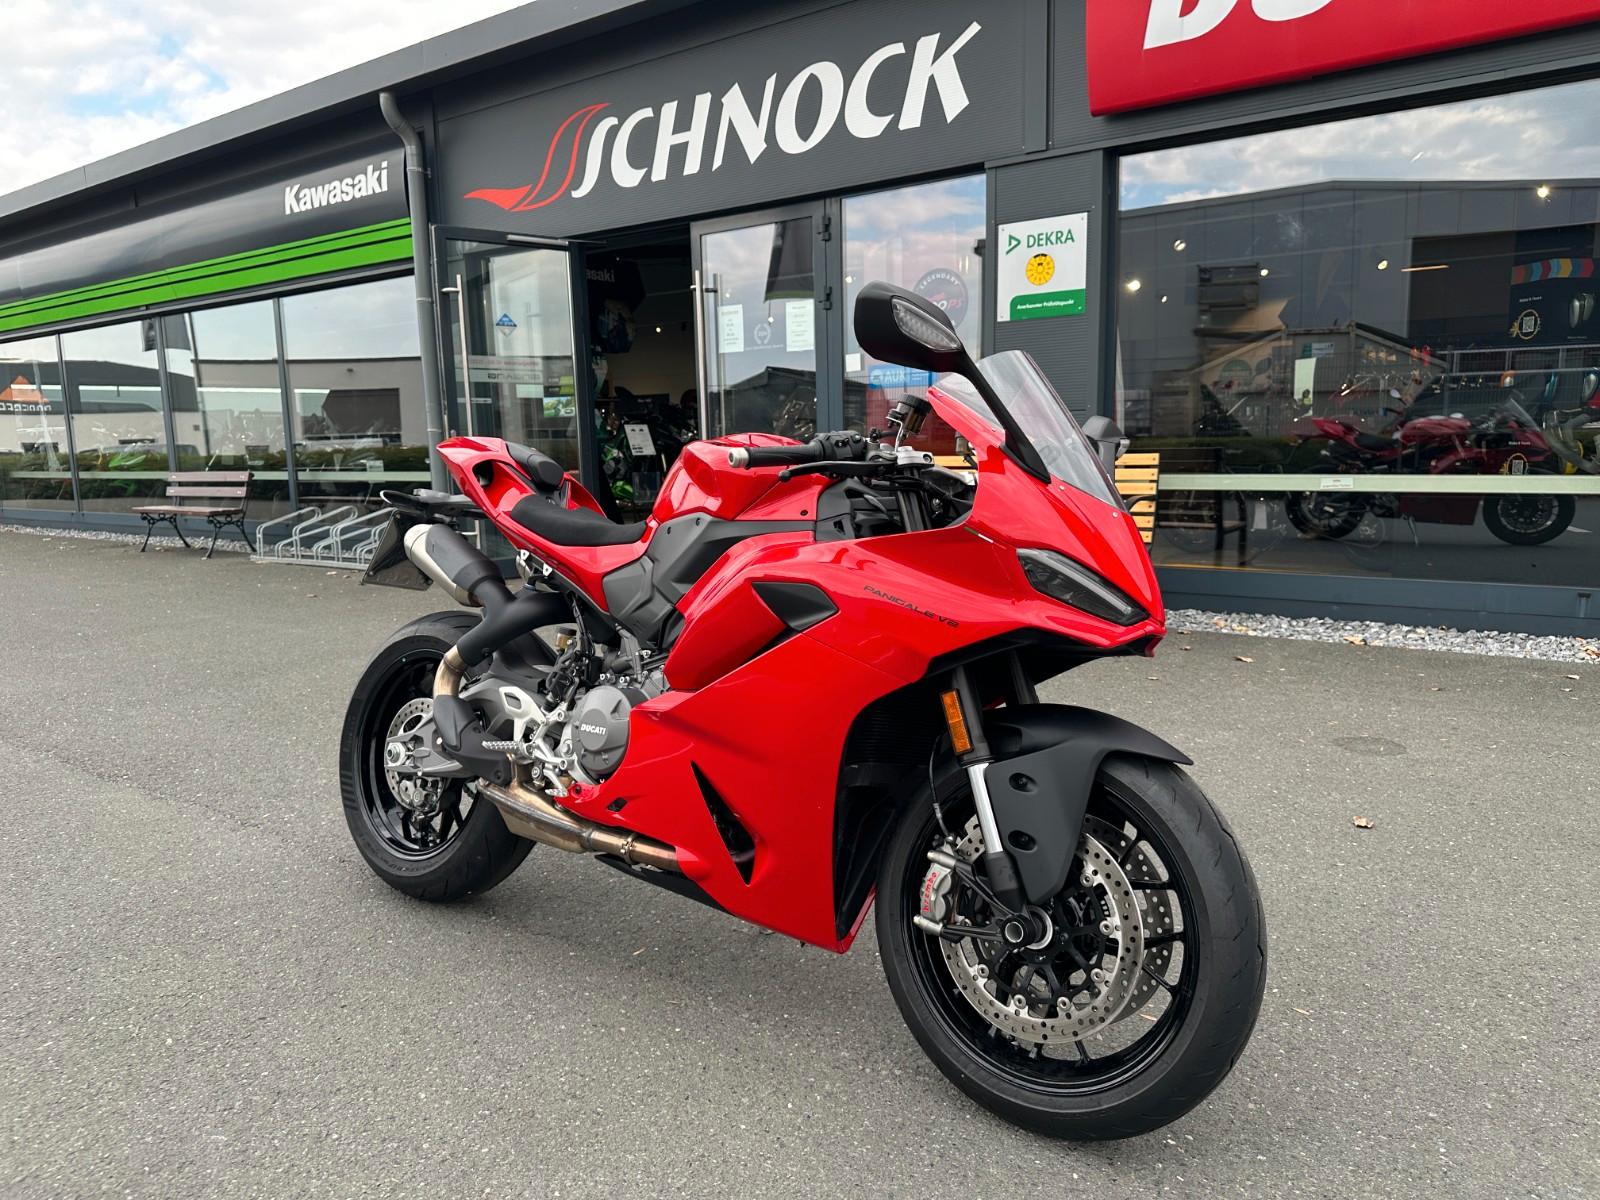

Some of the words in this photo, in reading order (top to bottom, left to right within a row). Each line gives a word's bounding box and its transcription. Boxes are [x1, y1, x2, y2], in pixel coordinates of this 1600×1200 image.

[571, 21, 981, 199] SCHNOCK
[284, 161, 389, 215] Kawasaki
[1026, 228, 1075, 249] DEKRA
[863, 585, 935, 619] PANIGALE
[937, 615, 960, 628] V2
[580, 724, 606, 735] DUCATI
[922, 872, 937, 913] brembo
